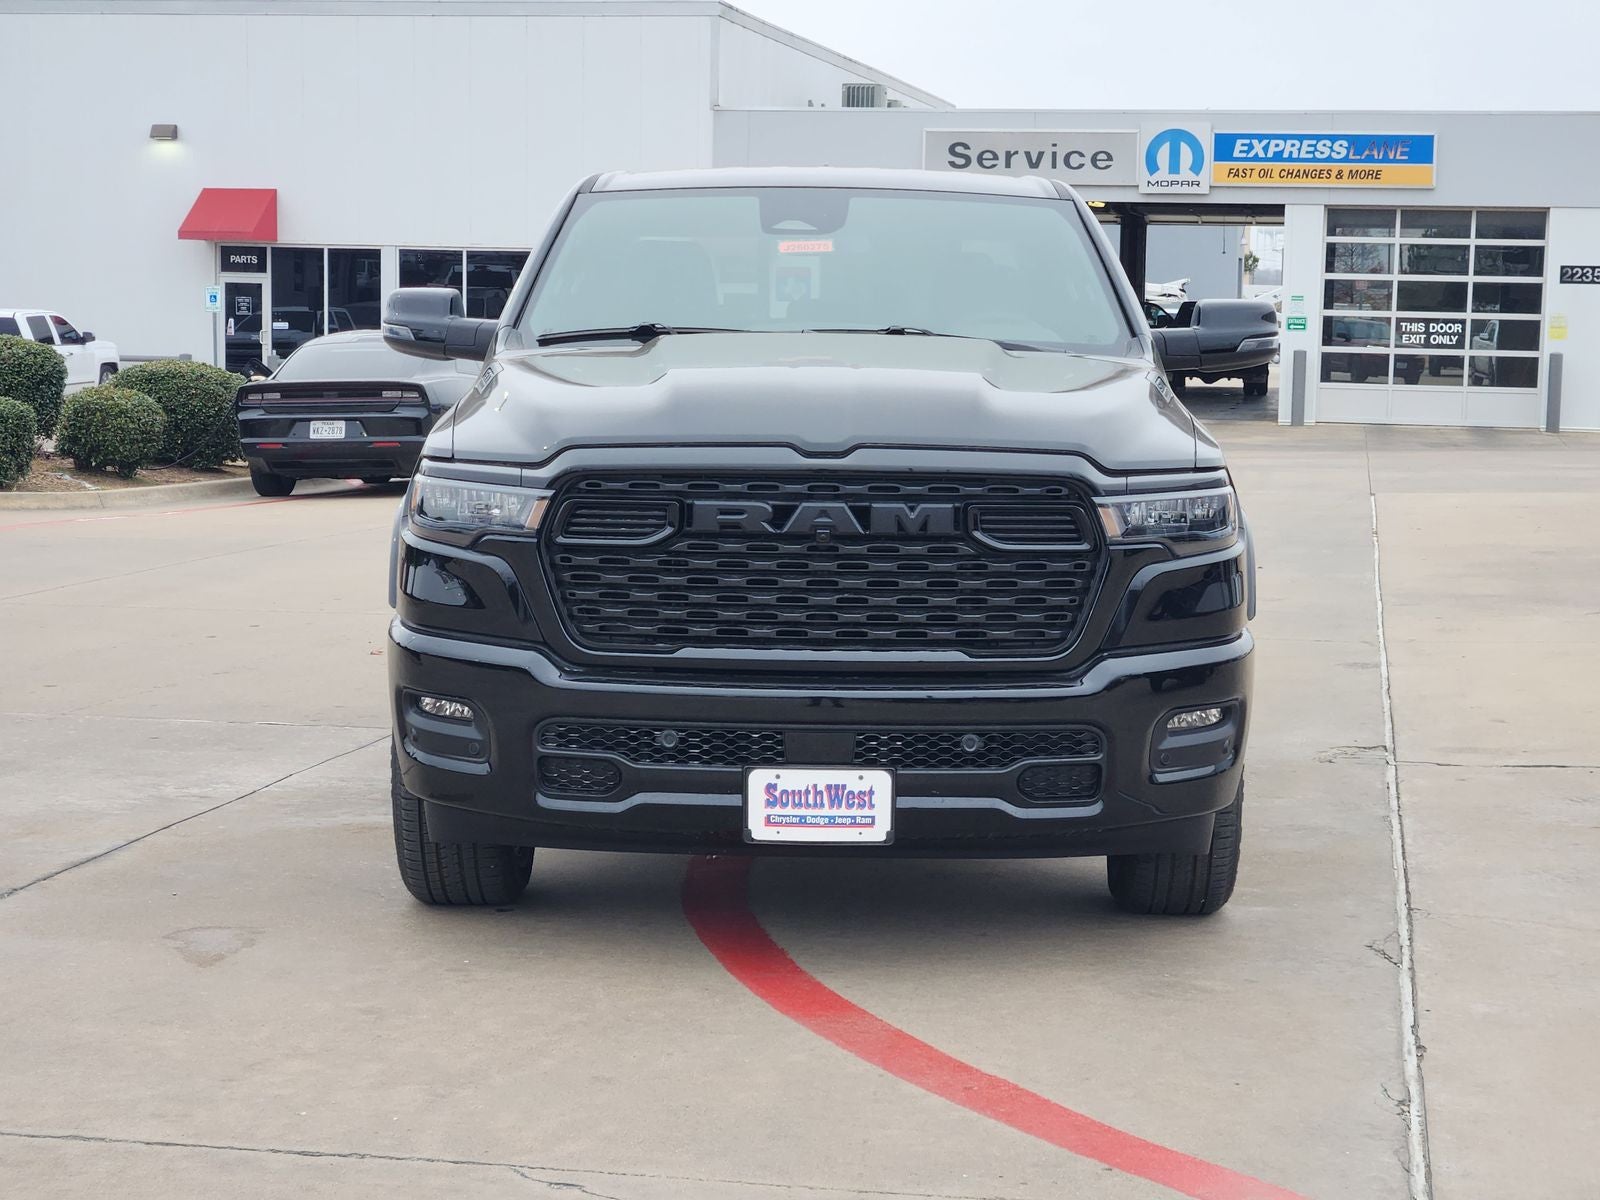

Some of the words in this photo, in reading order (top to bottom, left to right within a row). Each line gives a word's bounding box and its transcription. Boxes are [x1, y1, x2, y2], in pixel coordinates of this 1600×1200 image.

[947, 141, 1114, 170] Service
[1227, 168, 1255, 179] FAST
[1258, 168, 1275, 179] OIL
[1278, 168, 1332, 180] CHANGES
[1335, 169, 1344, 180] &
[1347, 169, 1383, 180] MORE
[1147, 180, 1201, 188] MOPAR
[230, 255, 258, 264] PARTS
[1562, 267, 1600, 282] 2235
[1400, 322, 1426, 333] THIS
[1429, 323, 1462, 333] DOOR
[1402, 334, 1426, 344] EXIT
[1430, 335, 1459, 345] ONLY
[690, 500, 955, 534] RAM
[764, 782, 875, 810] SouthWest
[770, 815, 800, 824] Chrysler
[806, 816, 829, 825] Dodge
[834, 816, 852, 826] Jeep
[856, 817, 872, 825] Ram
